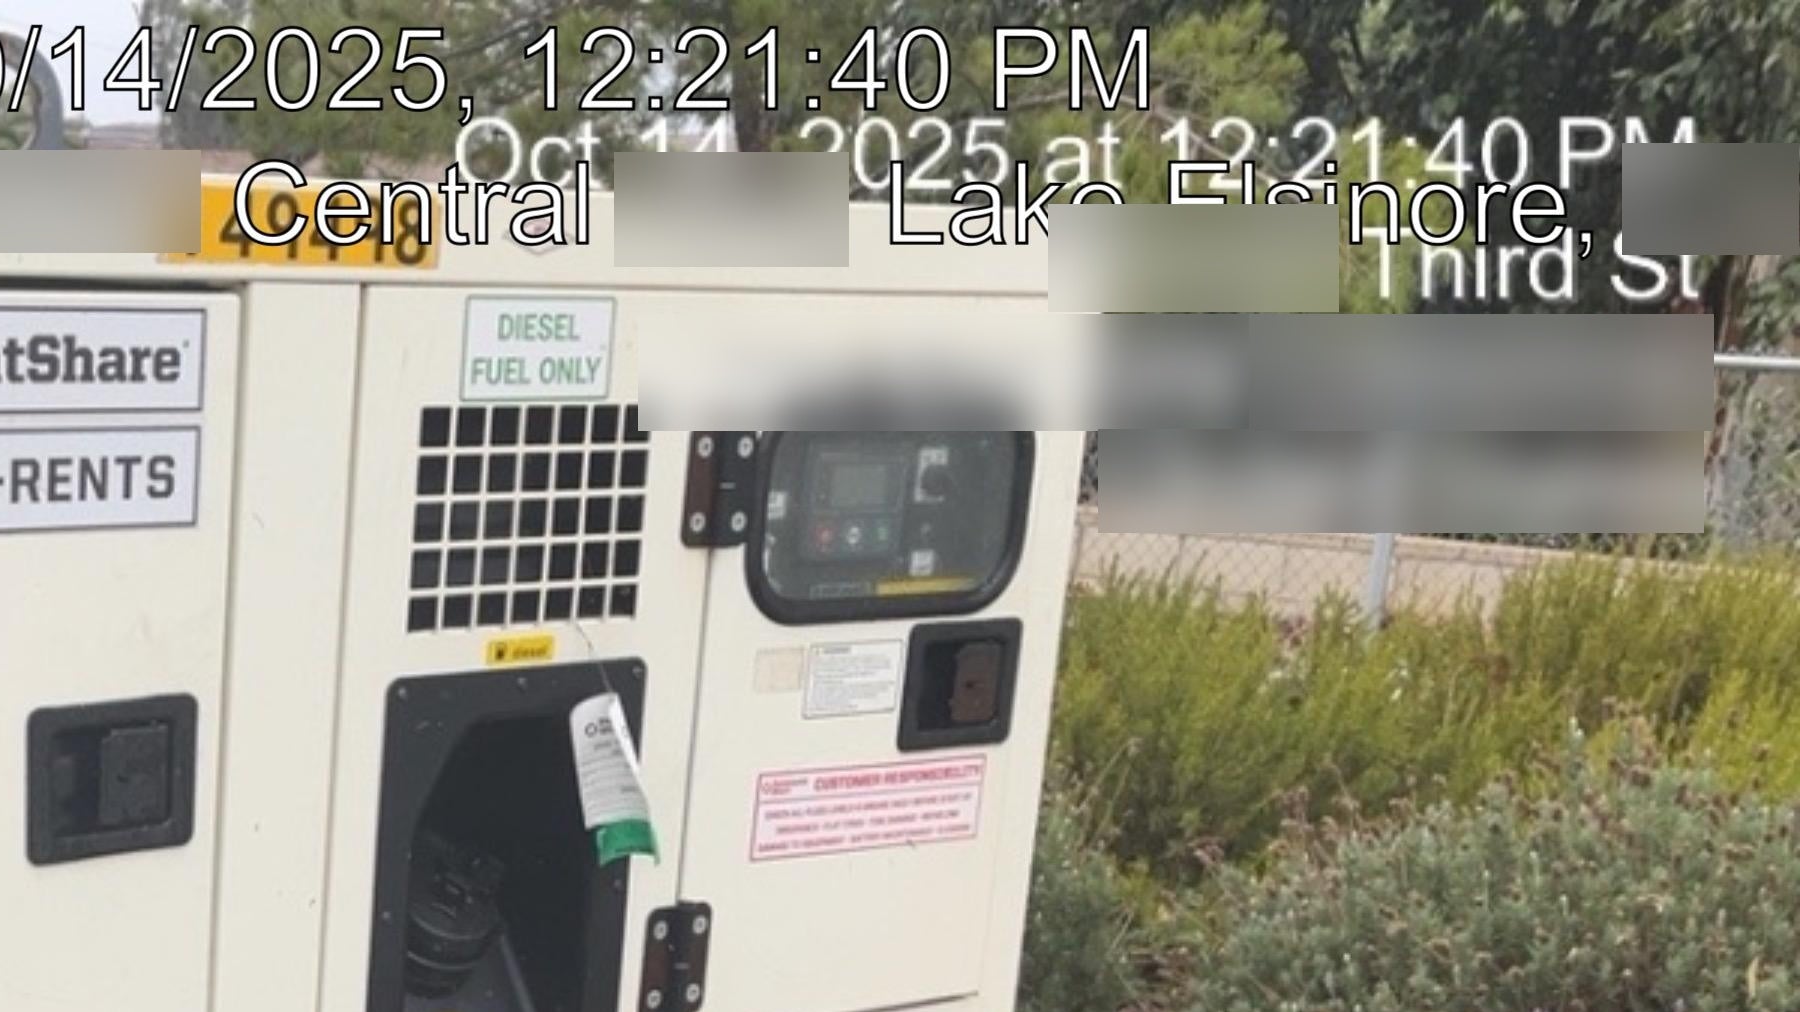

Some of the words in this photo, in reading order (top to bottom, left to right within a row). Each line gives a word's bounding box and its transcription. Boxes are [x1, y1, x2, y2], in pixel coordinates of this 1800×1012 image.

[497, 313, 580, 341] DIESEL
[470, 357, 531, 385] FUEL
[539, 356, 601, 384] ONLY
